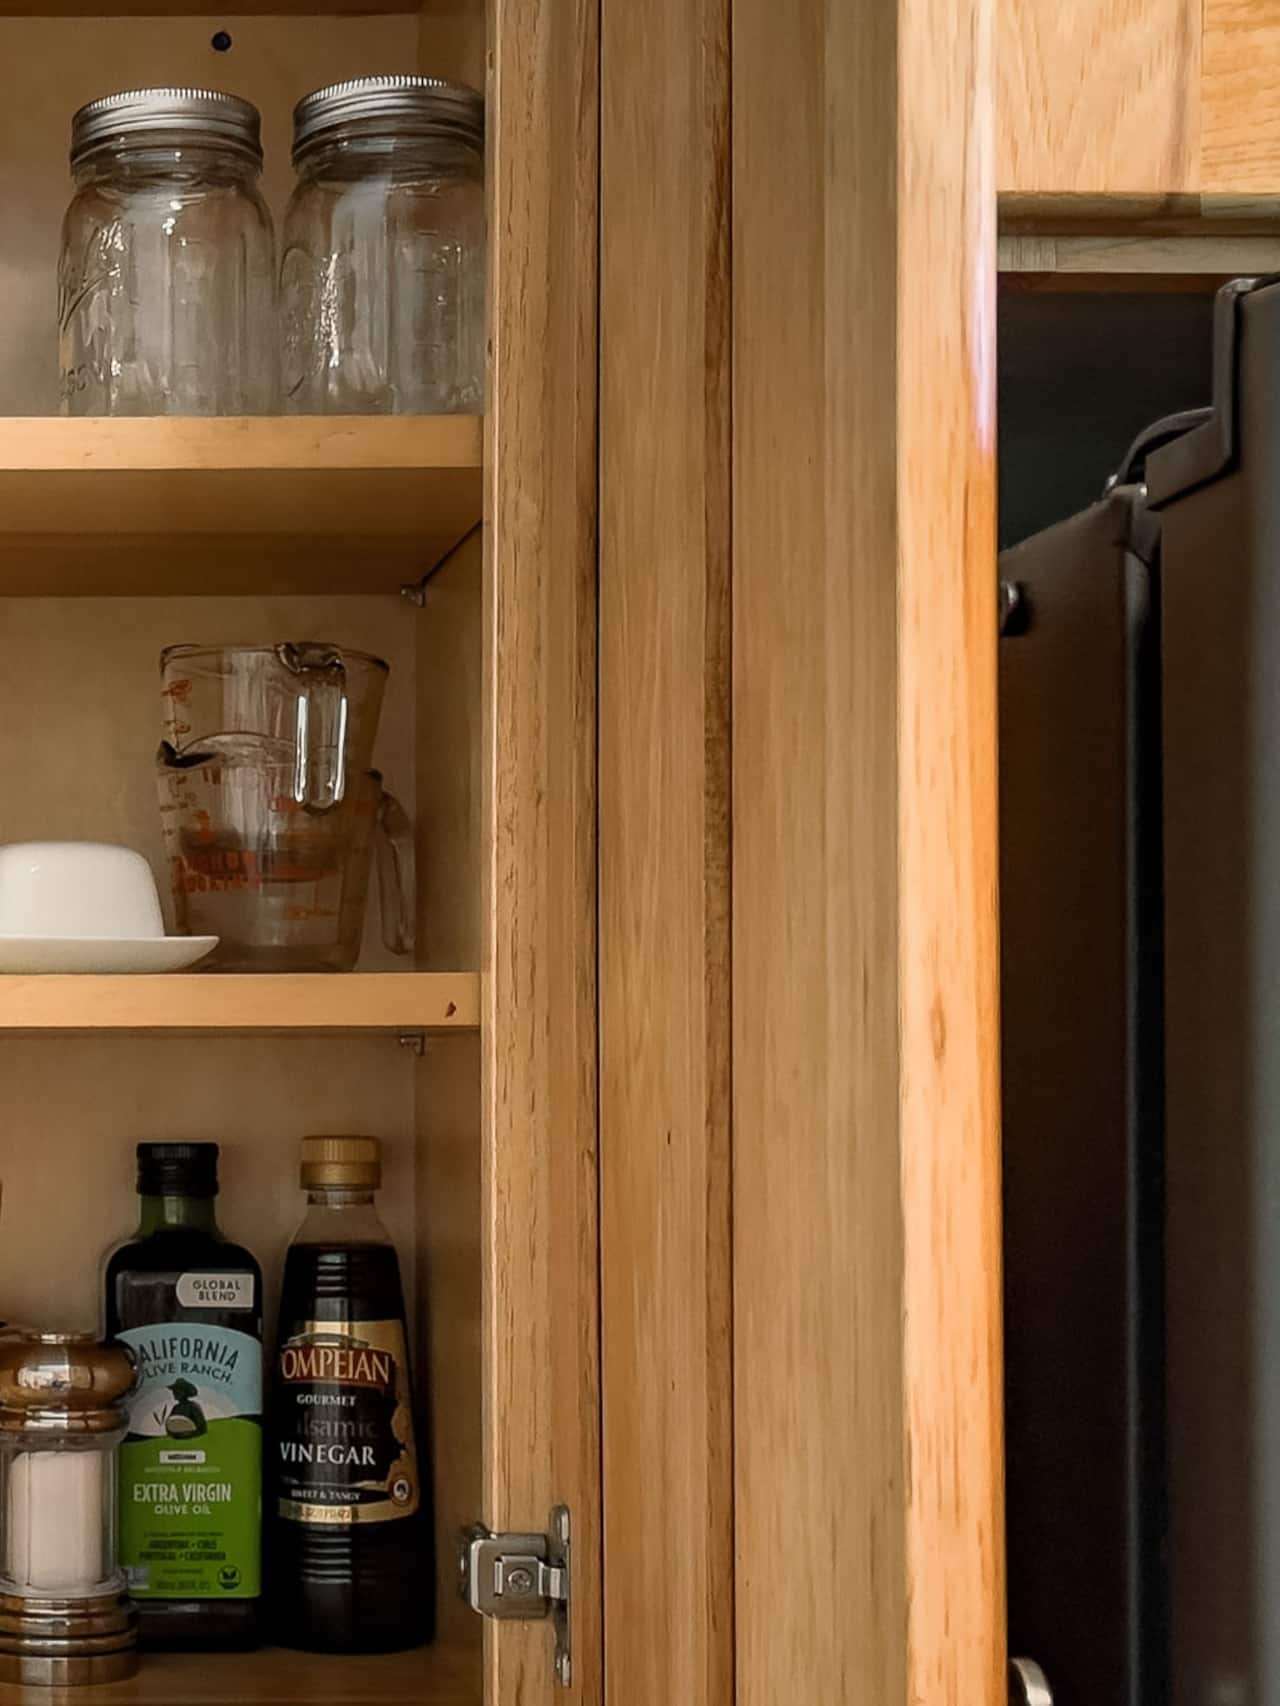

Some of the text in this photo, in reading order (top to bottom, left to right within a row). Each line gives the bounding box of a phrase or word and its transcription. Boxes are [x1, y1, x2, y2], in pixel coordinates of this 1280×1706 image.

[192, 1280, 240, 1290] GLOBAL
[199, 1291, 236, 1301] BLEND
[138, 1338, 239, 1371] ALIFORNIA
[144, 1362, 177, 1378] LIVE
[281, 1348, 389, 1384] OMPEIAN
[296, 1394, 356, 1407] GOURMET
[280, 1442, 376, 1465] VINEGAR
[133, 1483, 232, 1502] EXTRA VIRGIN
[154, 1504, 212, 1515] OLIVE OIL
